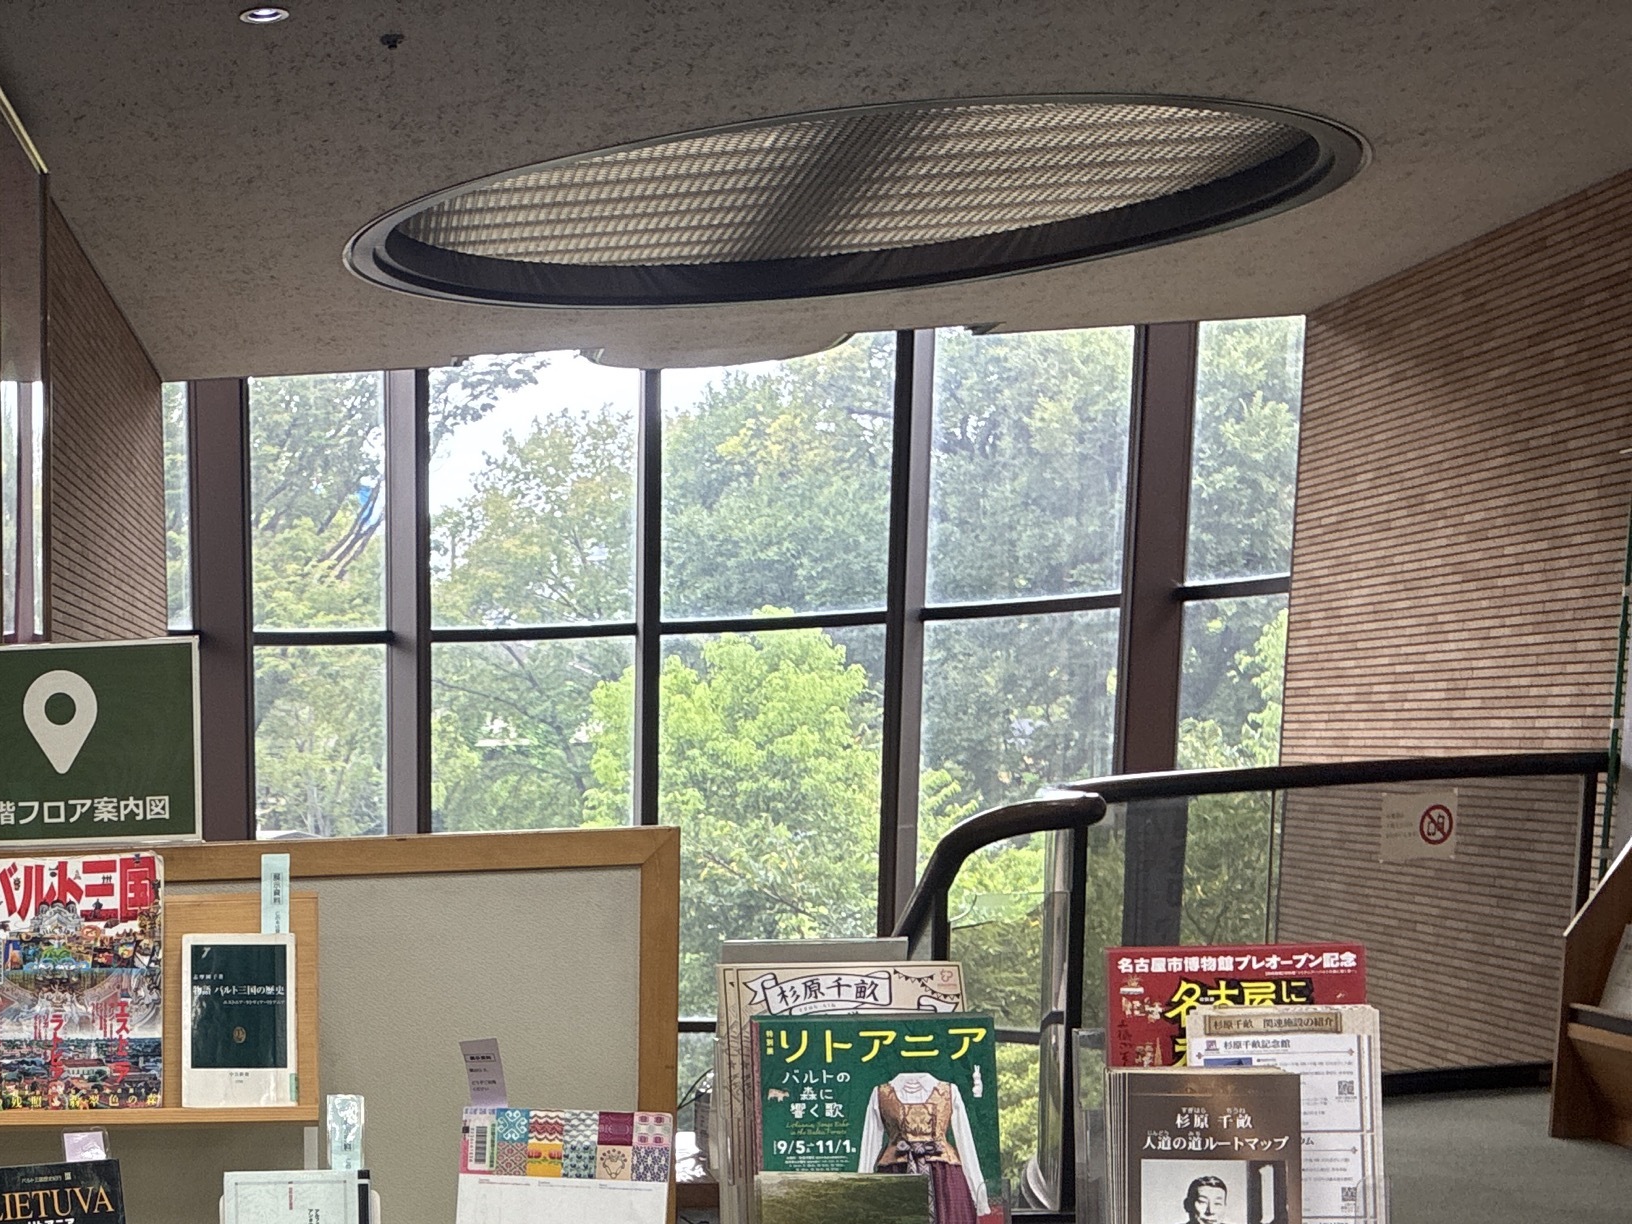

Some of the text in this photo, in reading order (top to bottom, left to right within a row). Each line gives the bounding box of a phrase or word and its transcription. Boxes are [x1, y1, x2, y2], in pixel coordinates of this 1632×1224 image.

[1117, 952, 1357, 974] 名古屋市博物館プレオープン記念
[214, 985, 285, 996] バルト三国の歴史
[778, 977, 880, 1006] 杉原千畝
[1213, 1016, 1333, 1029] 杉原千畝 関連施設の紹介
[780, 1027, 987, 1063] リトアニア
[1223, 1039, 1291, 1050] 杉原千畝記念館
[782, 1070, 851, 1084] バルトの
[800, 1086, 834, 1101] 森に
[790, 1102, 845, 1119] 響く歌
[1175, 1113, 1253, 1129] 杉原 千畝
[1142, 1135, 1289, 1151] 人道の道ルートマップ
